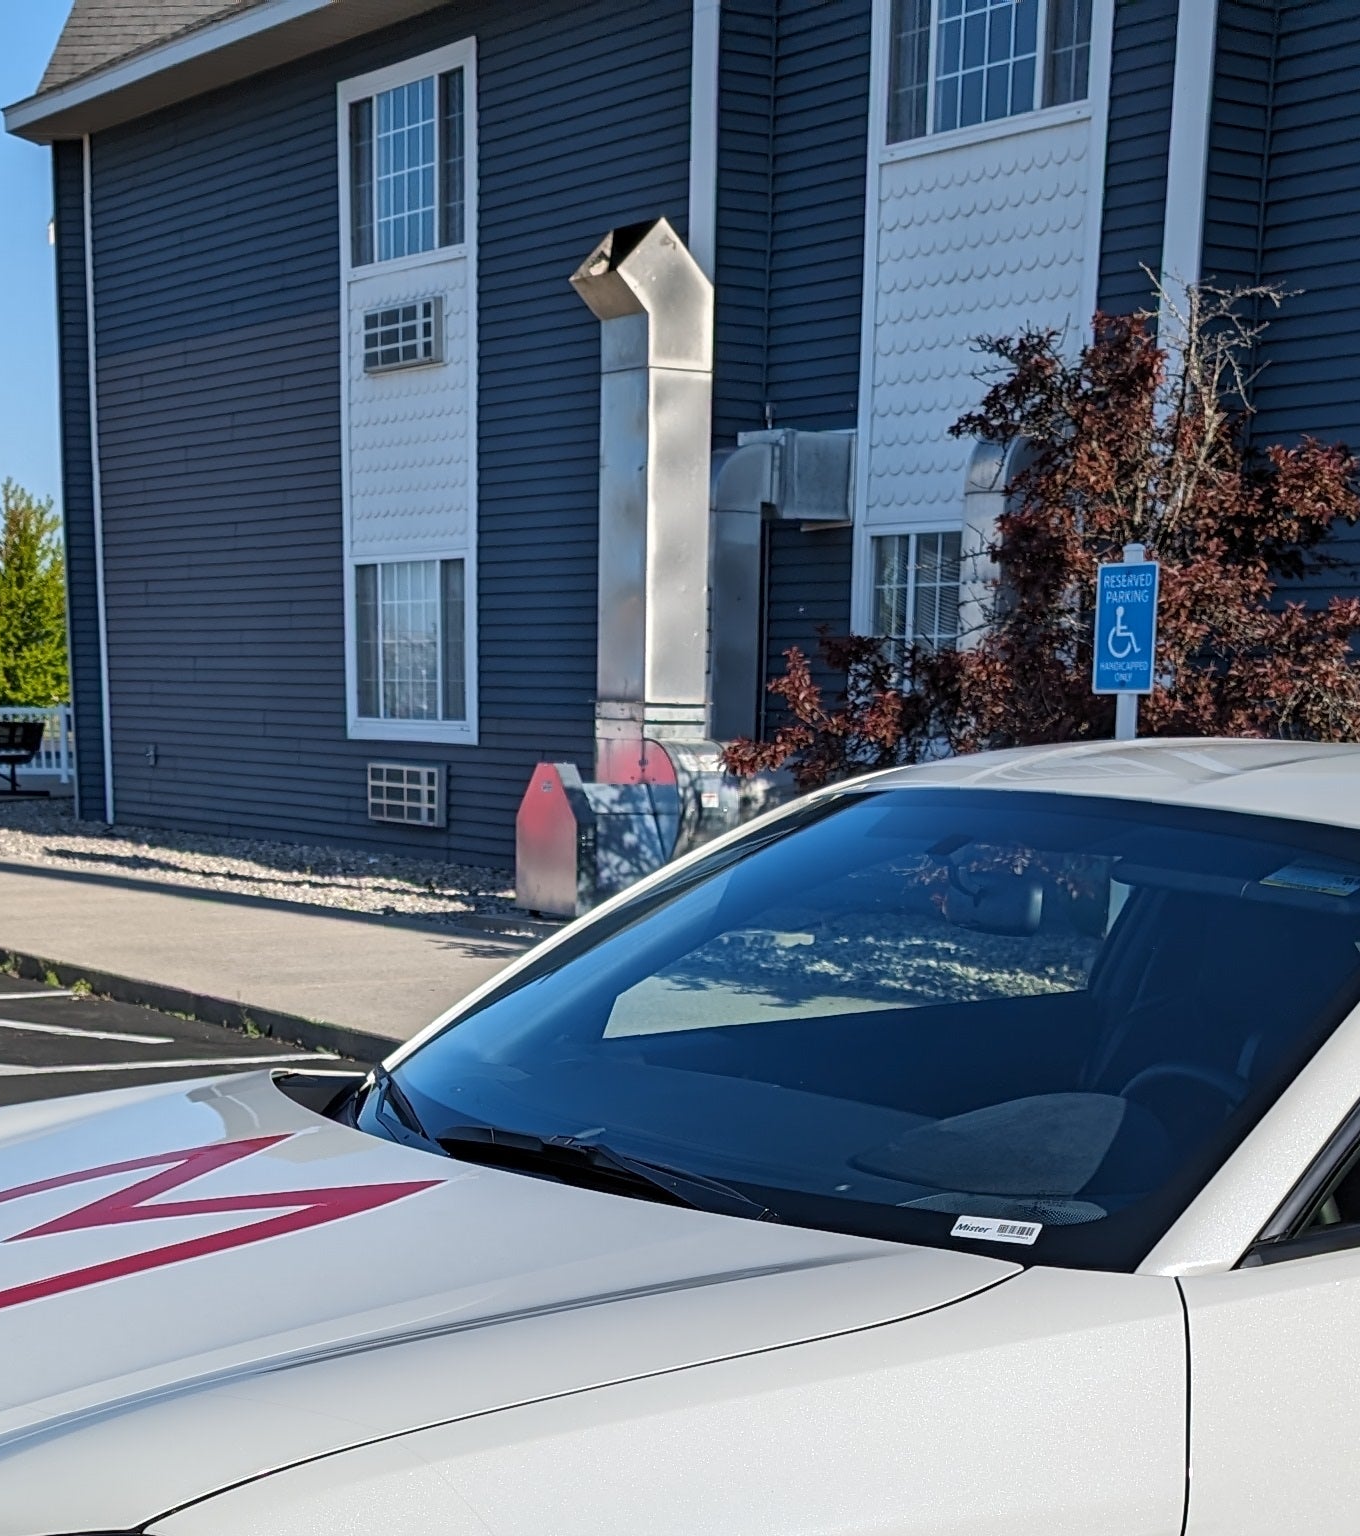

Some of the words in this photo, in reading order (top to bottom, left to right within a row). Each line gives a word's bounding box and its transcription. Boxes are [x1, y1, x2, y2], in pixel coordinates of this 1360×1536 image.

[1104, 574, 1152, 588] RESERVED
[1106, 590, 1149, 603] PARKING
[1100, 661, 1148, 671] HANDICAPPED
[1114, 672, 1132, 681] ONLY
[956, 1223, 992, 1234] Mister
